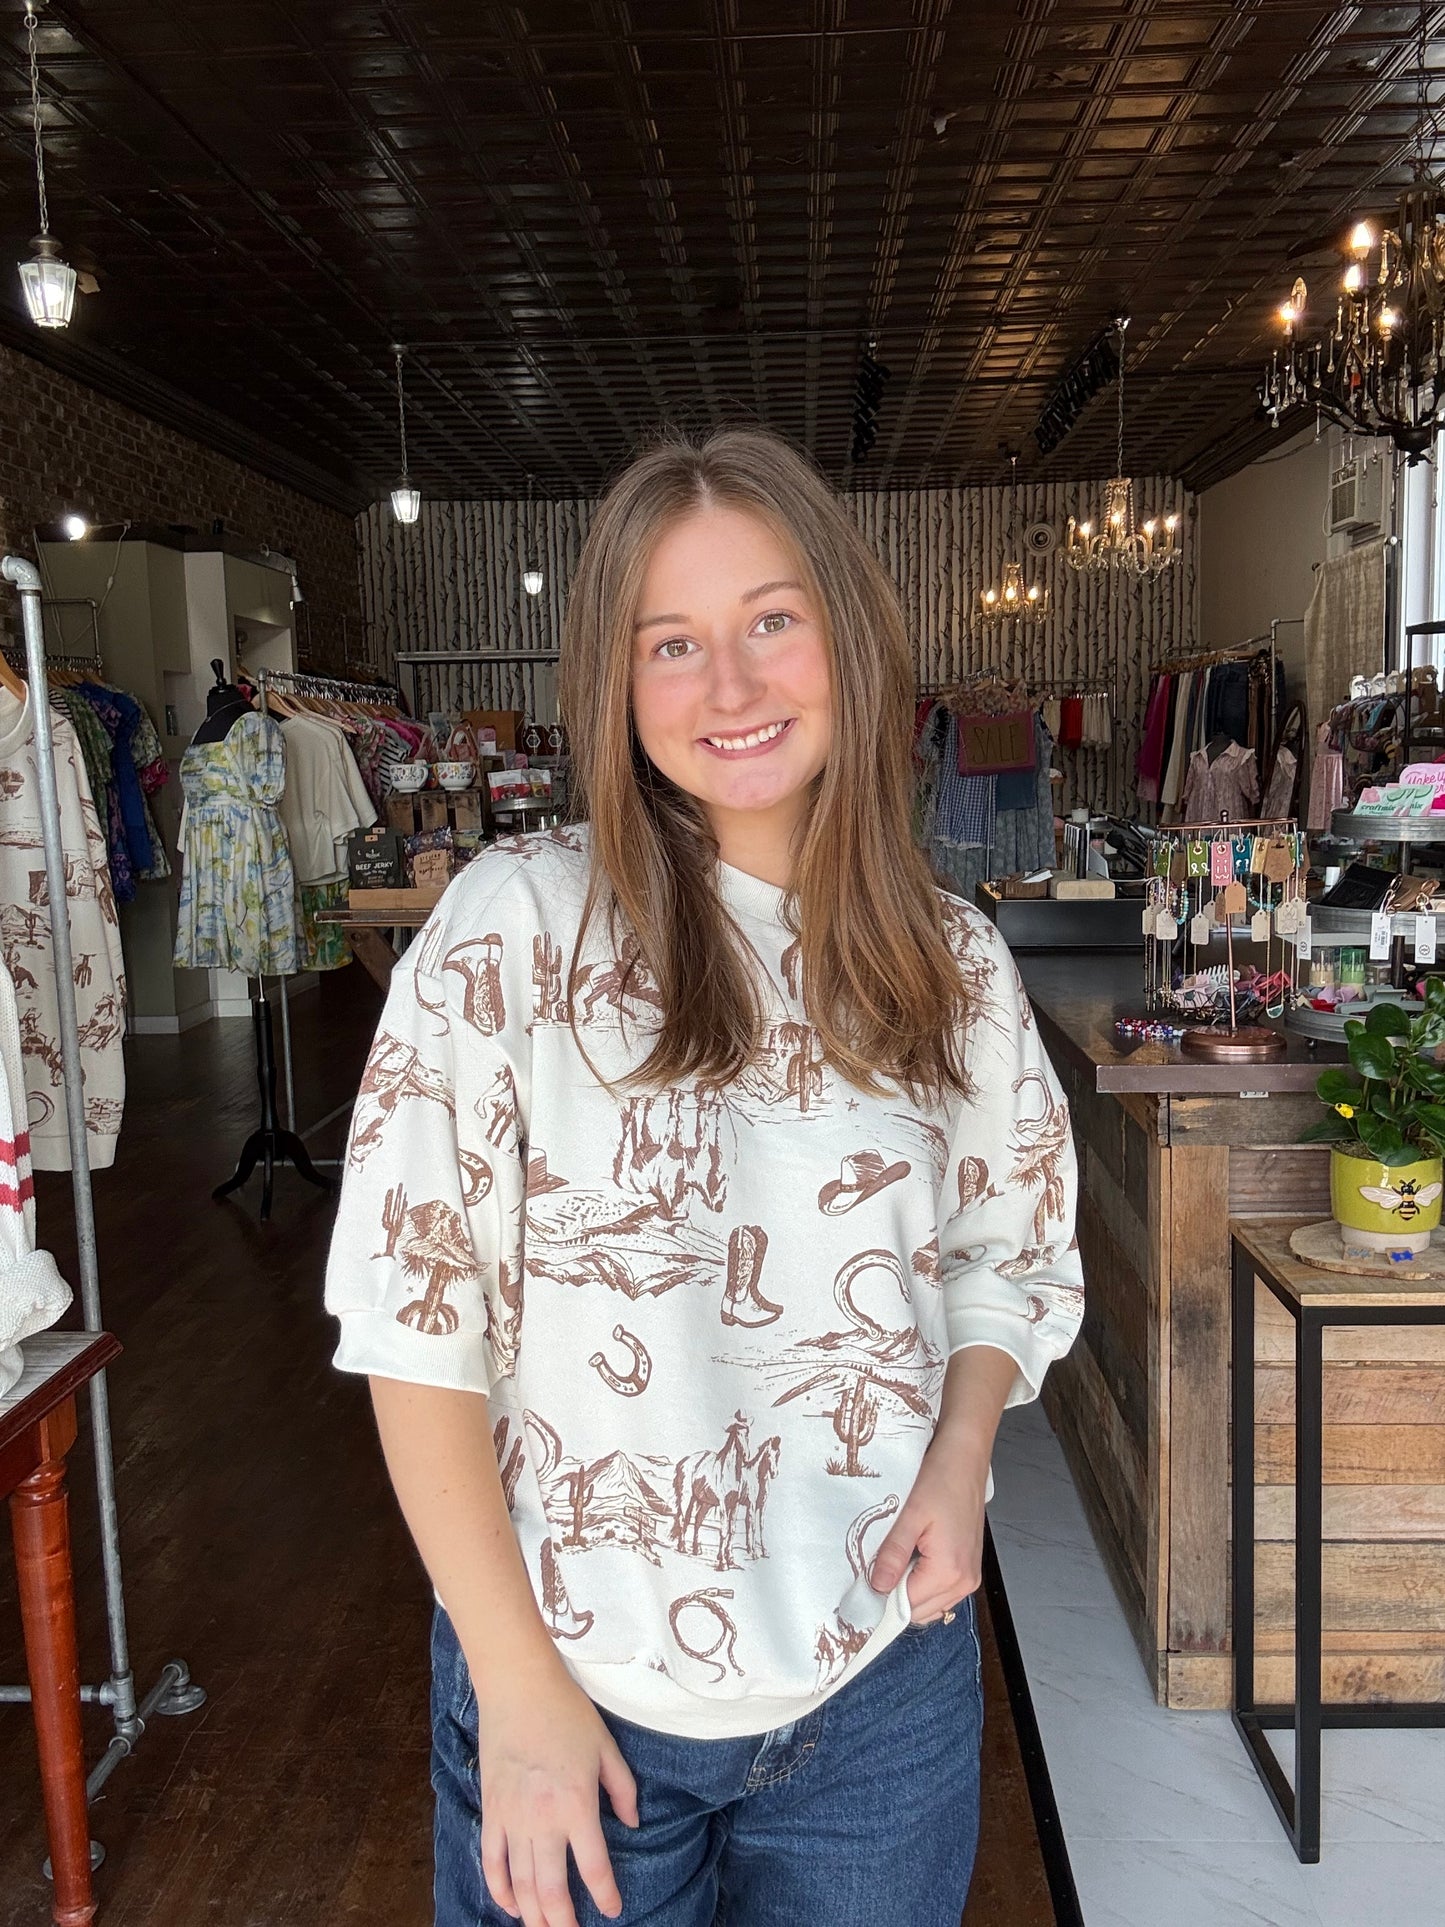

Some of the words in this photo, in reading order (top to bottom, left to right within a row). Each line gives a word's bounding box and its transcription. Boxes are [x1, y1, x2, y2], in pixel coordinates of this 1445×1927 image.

[972, 723, 1025, 764] SALE
[355, 863, 372, 871] BEEF
[373, 860, 394, 869] JERKY
